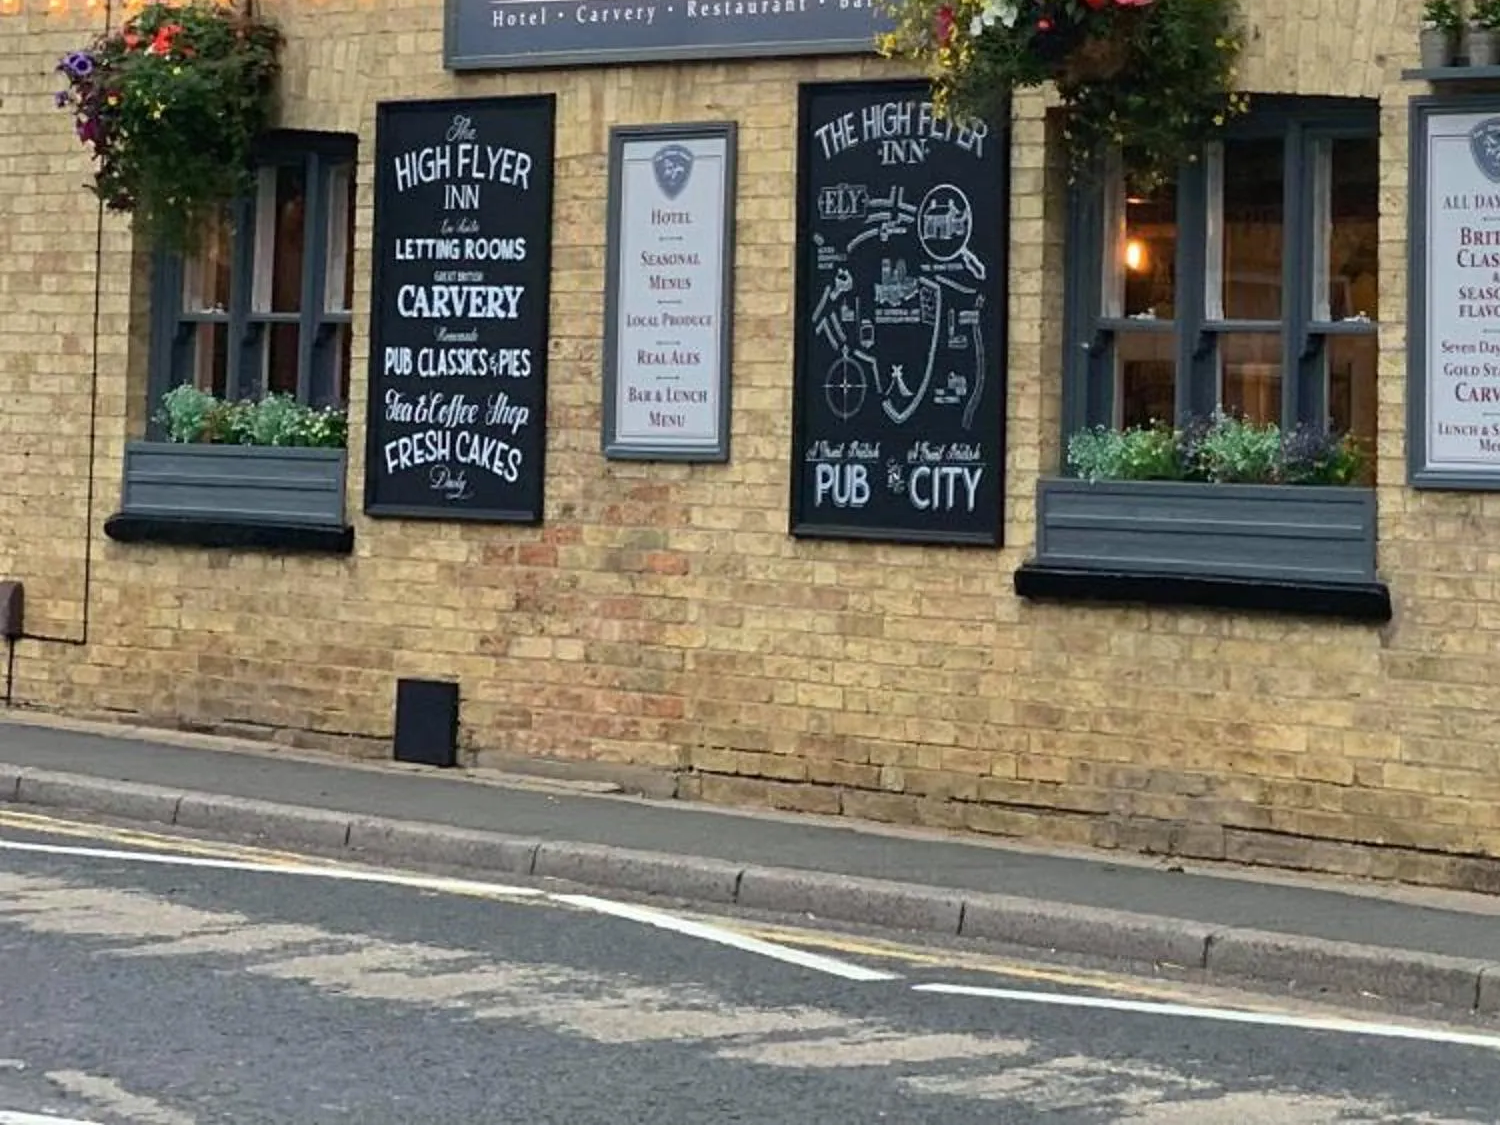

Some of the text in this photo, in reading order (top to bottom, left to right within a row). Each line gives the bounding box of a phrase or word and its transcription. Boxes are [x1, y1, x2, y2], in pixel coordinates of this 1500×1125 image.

[492, 7, 546, 28] Hotel
[576, 4, 656, 26] Carvery
[446, 114, 477, 142] The
[814, 111, 859, 159] THE
[862, 102, 911, 142] HIGH
[881, 139, 927, 165] INN
[395, 144, 532, 192] HIGH FLYER
[444, 184, 480, 210] INN
[825, 190, 861, 213] ELY
[1443, 195, 1470, 210] ALL
[651, 208, 693, 225] HOTEL
[395, 237, 526, 260] LETTING ROOMS
[640, 250, 701, 267] SEASONAL
[649, 276, 692, 290] MENUS
[397, 285, 525, 318] CARVERY
[626, 313, 712, 328] LOCAL PRODUCE
[637, 350, 701, 364] REAL ALES
[1441, 341, 1476, 354] Seven
[384, 346, 413, 376] PUB
[417, 347, 489, 377] CLASSICS
[499, 348, 531, 377] PIES
[1443, 363, 1480, 377] GOLD
[628, 387, 653, 403] BAR
[665, 387, 708, 404] LUNCH
[385, 388, 412, 421] Tea
[428, 390, 480, 428] Coffee
[485, 391, 530, 435] Shop
[648, 411, 685, 428] MENU
[1438, 423, 1478, 436] LUNCH
[384, 430, 523, 483] FRESH CAKES
[815, 463, 870, 507] PUB
[911, 466, 983, 511] CITY
